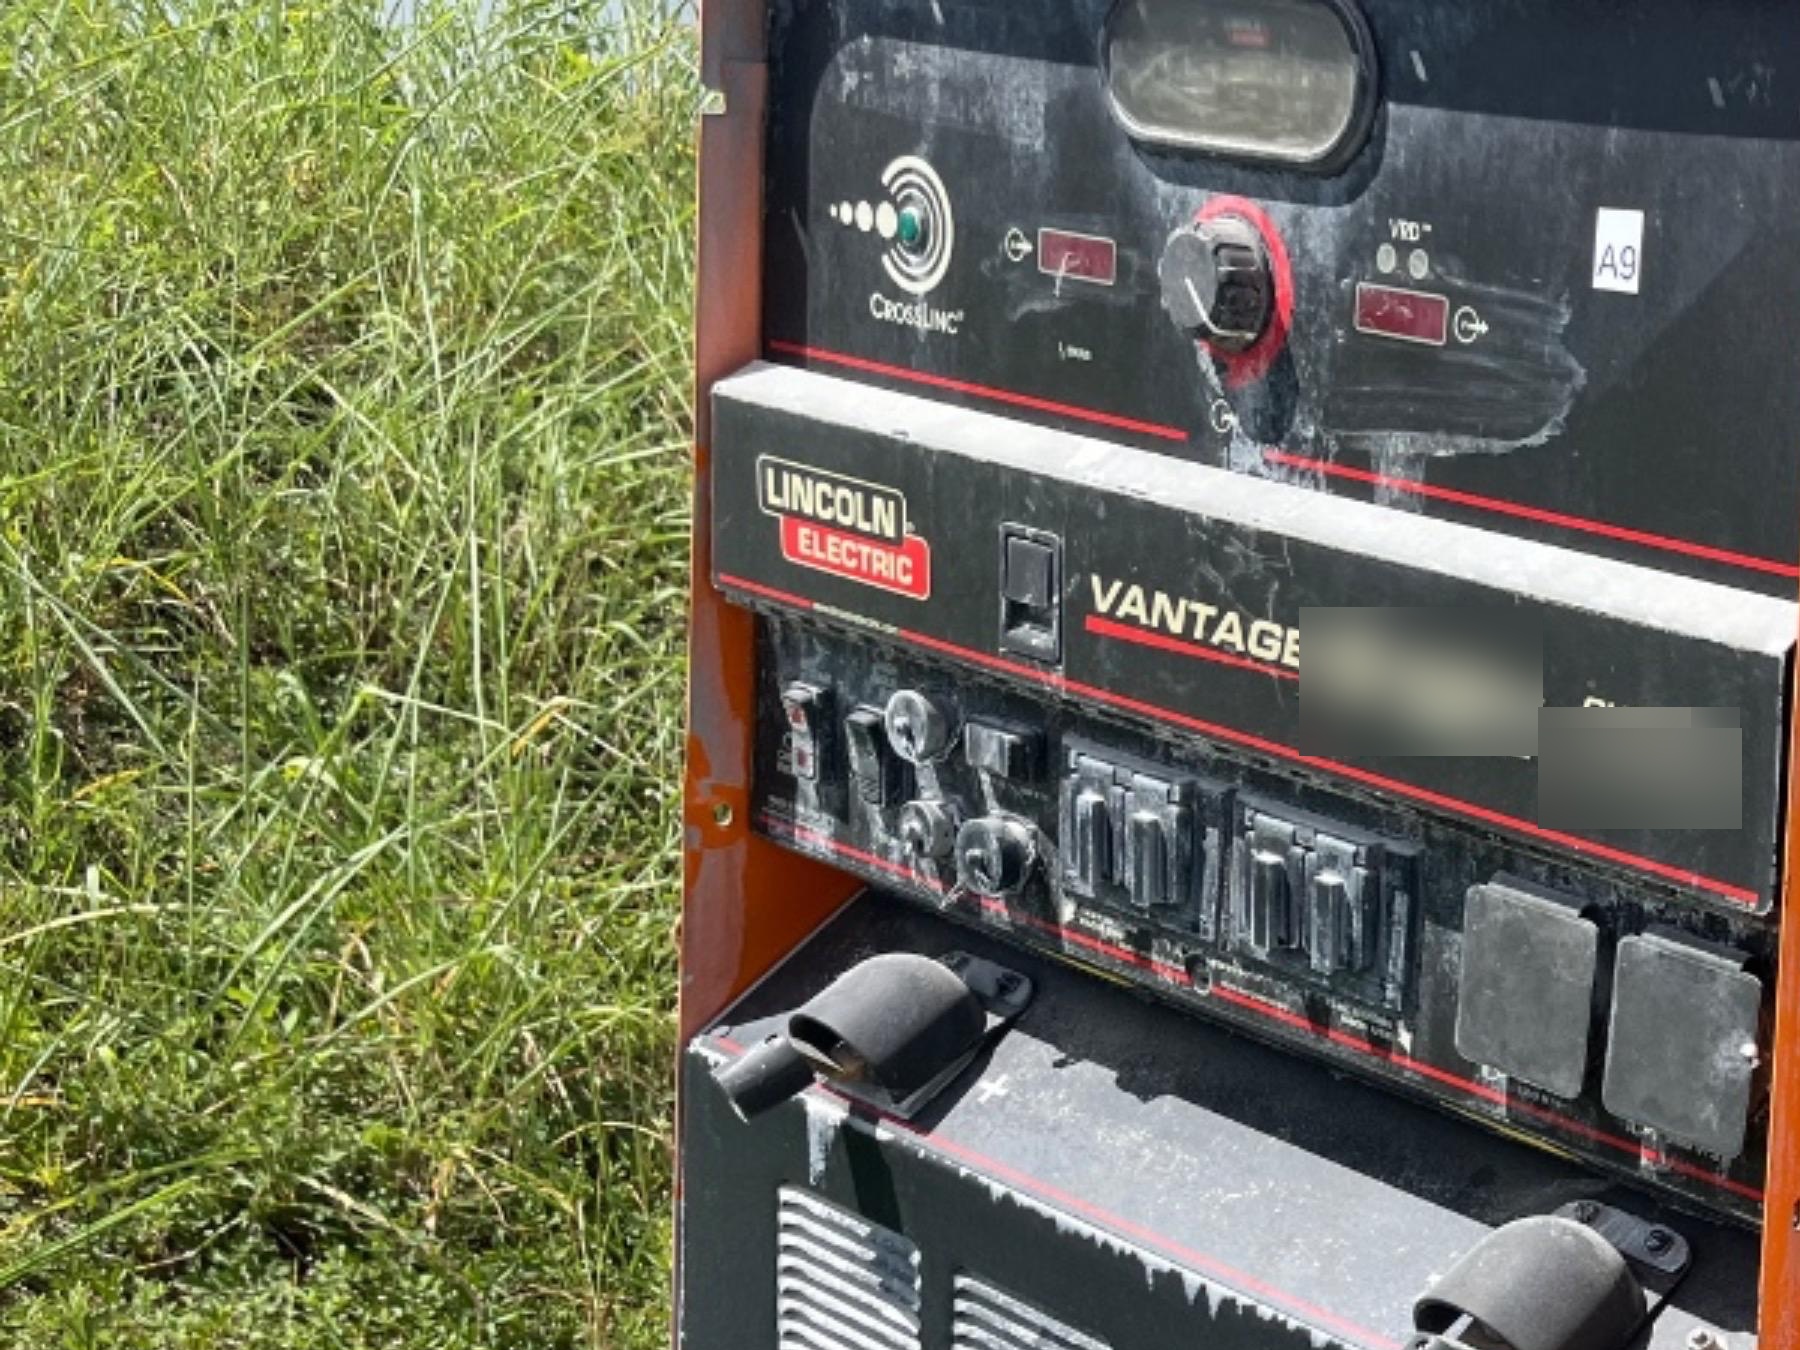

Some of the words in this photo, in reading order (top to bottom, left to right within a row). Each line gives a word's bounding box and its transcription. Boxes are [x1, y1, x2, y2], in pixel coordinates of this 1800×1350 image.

[1597, 244, 1638, 281] A9
[766, 466, 898, 538] LINCOLN
[796, 528, 914, 586] ELECTRIC
